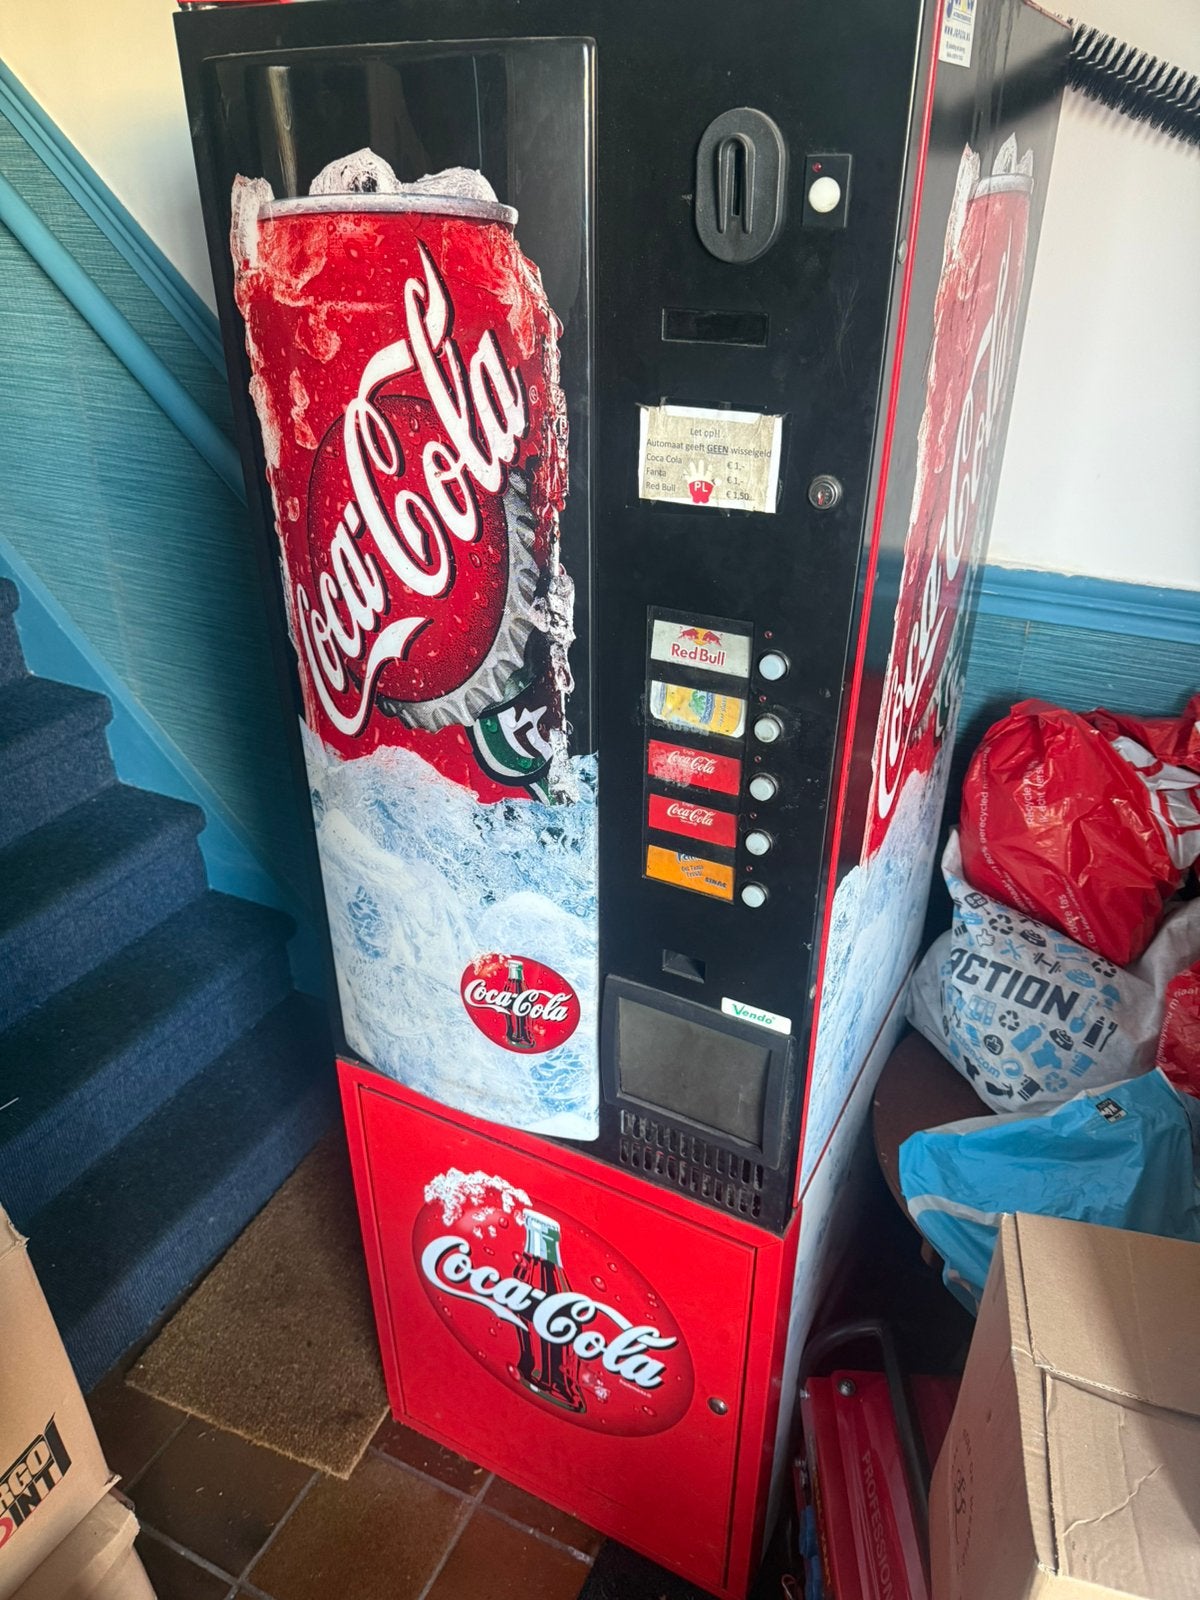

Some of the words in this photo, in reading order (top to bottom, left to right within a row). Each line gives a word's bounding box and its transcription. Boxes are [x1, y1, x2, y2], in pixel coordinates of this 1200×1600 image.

[690, 428, 702, 436] Let
[646, 438, 684, 450] Automaat
[685, 443, 705, 452] geeft
[707, 444, 729, 455] GEEN
[731, 446, 772, 459] wisselgeld
[646, 453, 664, 462] Coca
[665, 455, 682, 464] Cola
[646, 466, 667, 478] Fanta
[299, 237, 528, 736] Coca-Cola
[645, 481, 660, 490] Red
[661, 483, 676, 492] Bull
[693, 481, 709, 493] PL
[671, 643, 698, 660] Red
[699, 648, 726, 666] Bull
[667, 750, 717, 775] Coca-Cola
[666, 803, 716, 826] Coca-Cola
[464, 979, 573, 1022] Coca-Cola
[731, 1003, 773, 1025] Vendo
[421, 1235, 678, 1389] Coca-Cola
